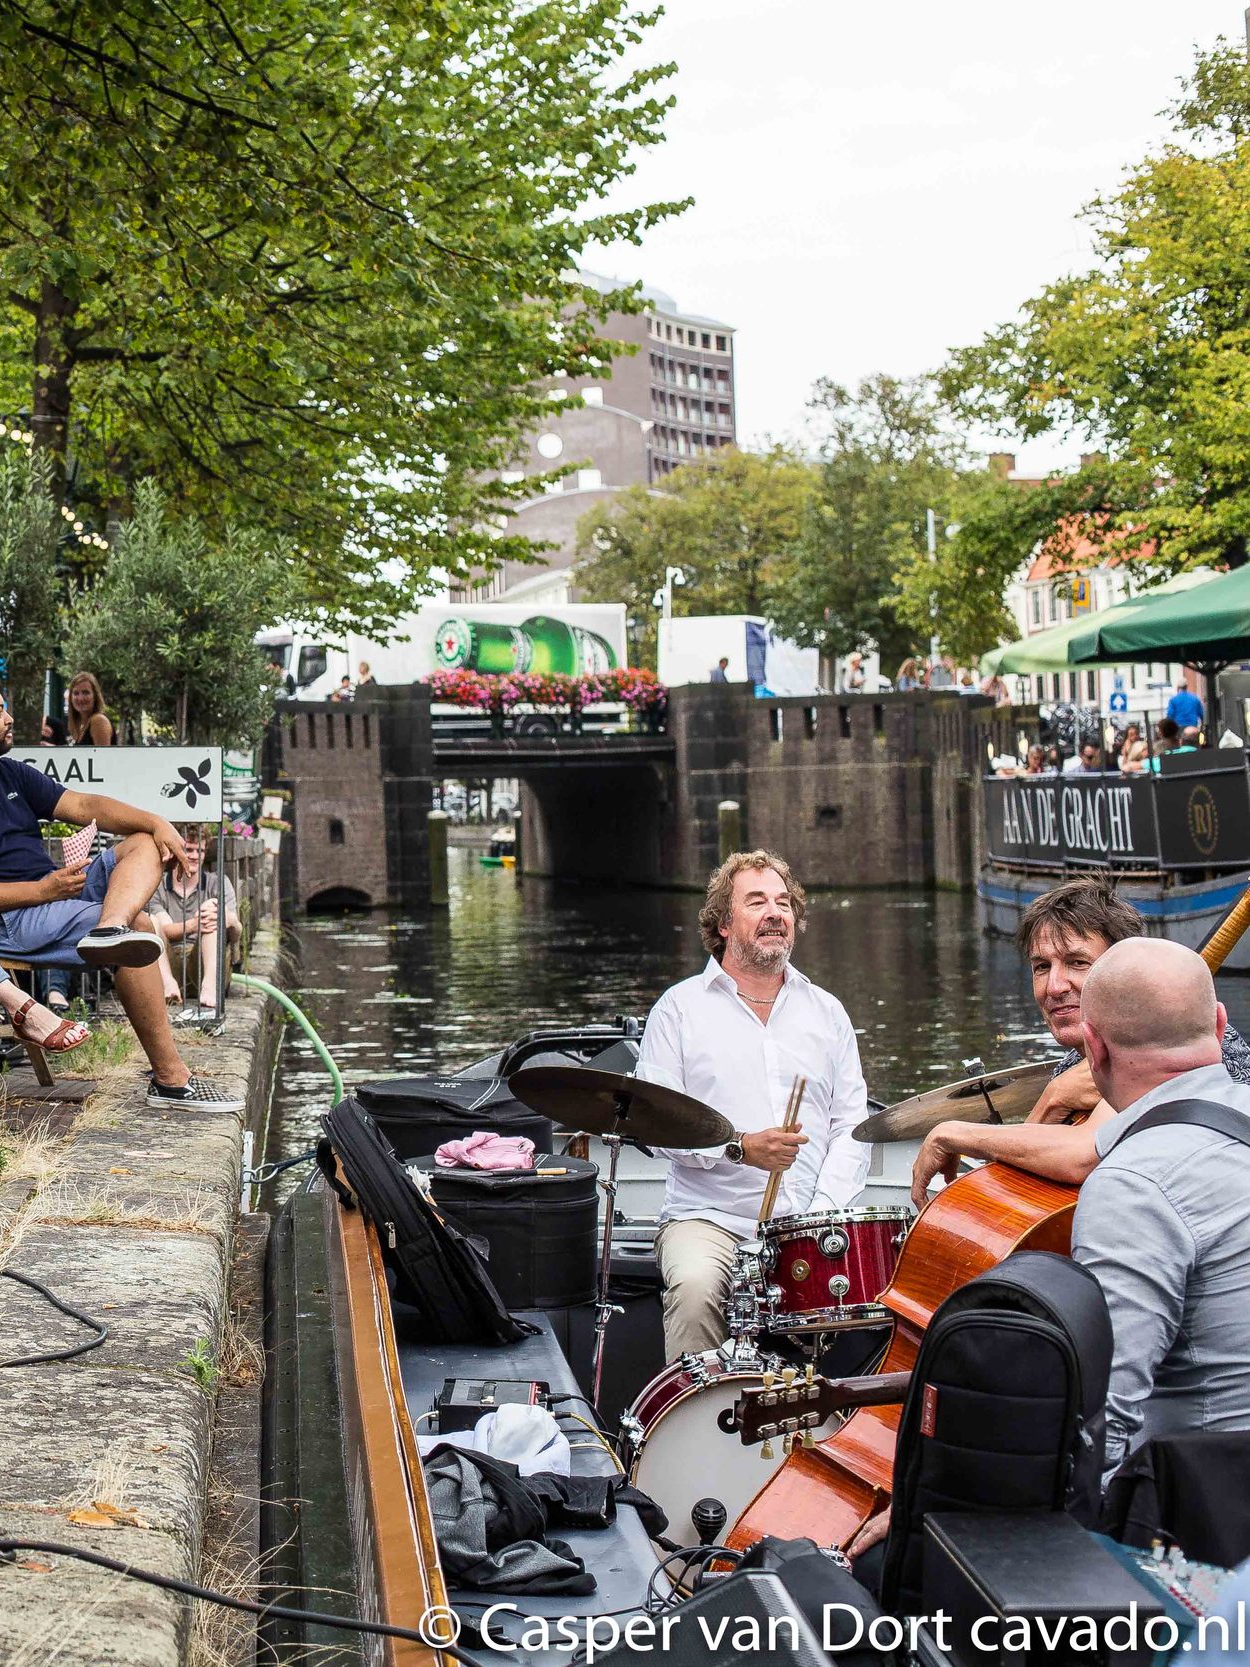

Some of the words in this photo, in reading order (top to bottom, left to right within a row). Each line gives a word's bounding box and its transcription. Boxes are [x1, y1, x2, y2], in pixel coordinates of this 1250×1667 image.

[23, 758, 103, 783] AAL
[1003, 787, 1035, 844] AAN
[1036, 787, 1059, 847] DE
[1062, 787, 1134, 851] GRACHT
